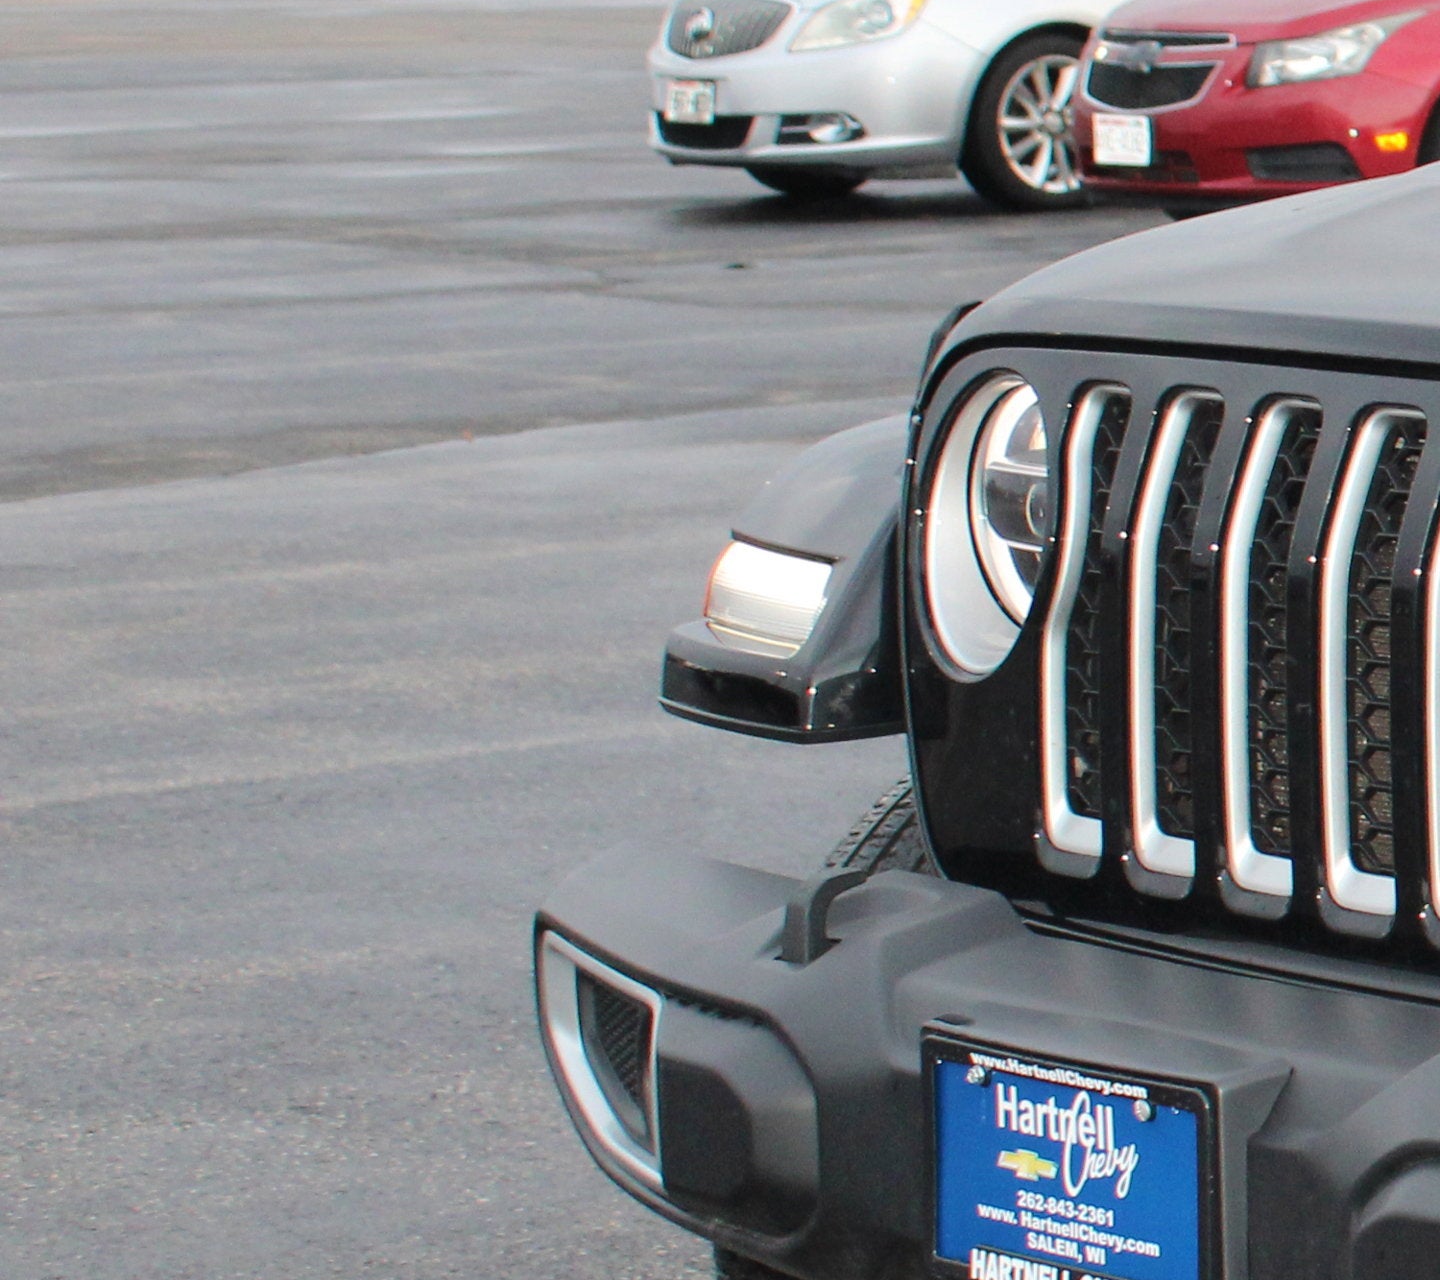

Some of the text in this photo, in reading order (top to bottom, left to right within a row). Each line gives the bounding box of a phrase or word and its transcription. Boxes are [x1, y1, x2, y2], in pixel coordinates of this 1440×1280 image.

[970, 1051, 1148, 1099] www.HartnellChevy.com
[995, 1082, 1115, 1149] Hartnell
[1063, 1090, 1140, 1198] Chevy
[1016, 1190, 1115, 1227] 262-843-2361
[1026, 1232, 1106, 1265] SALEM, WI
